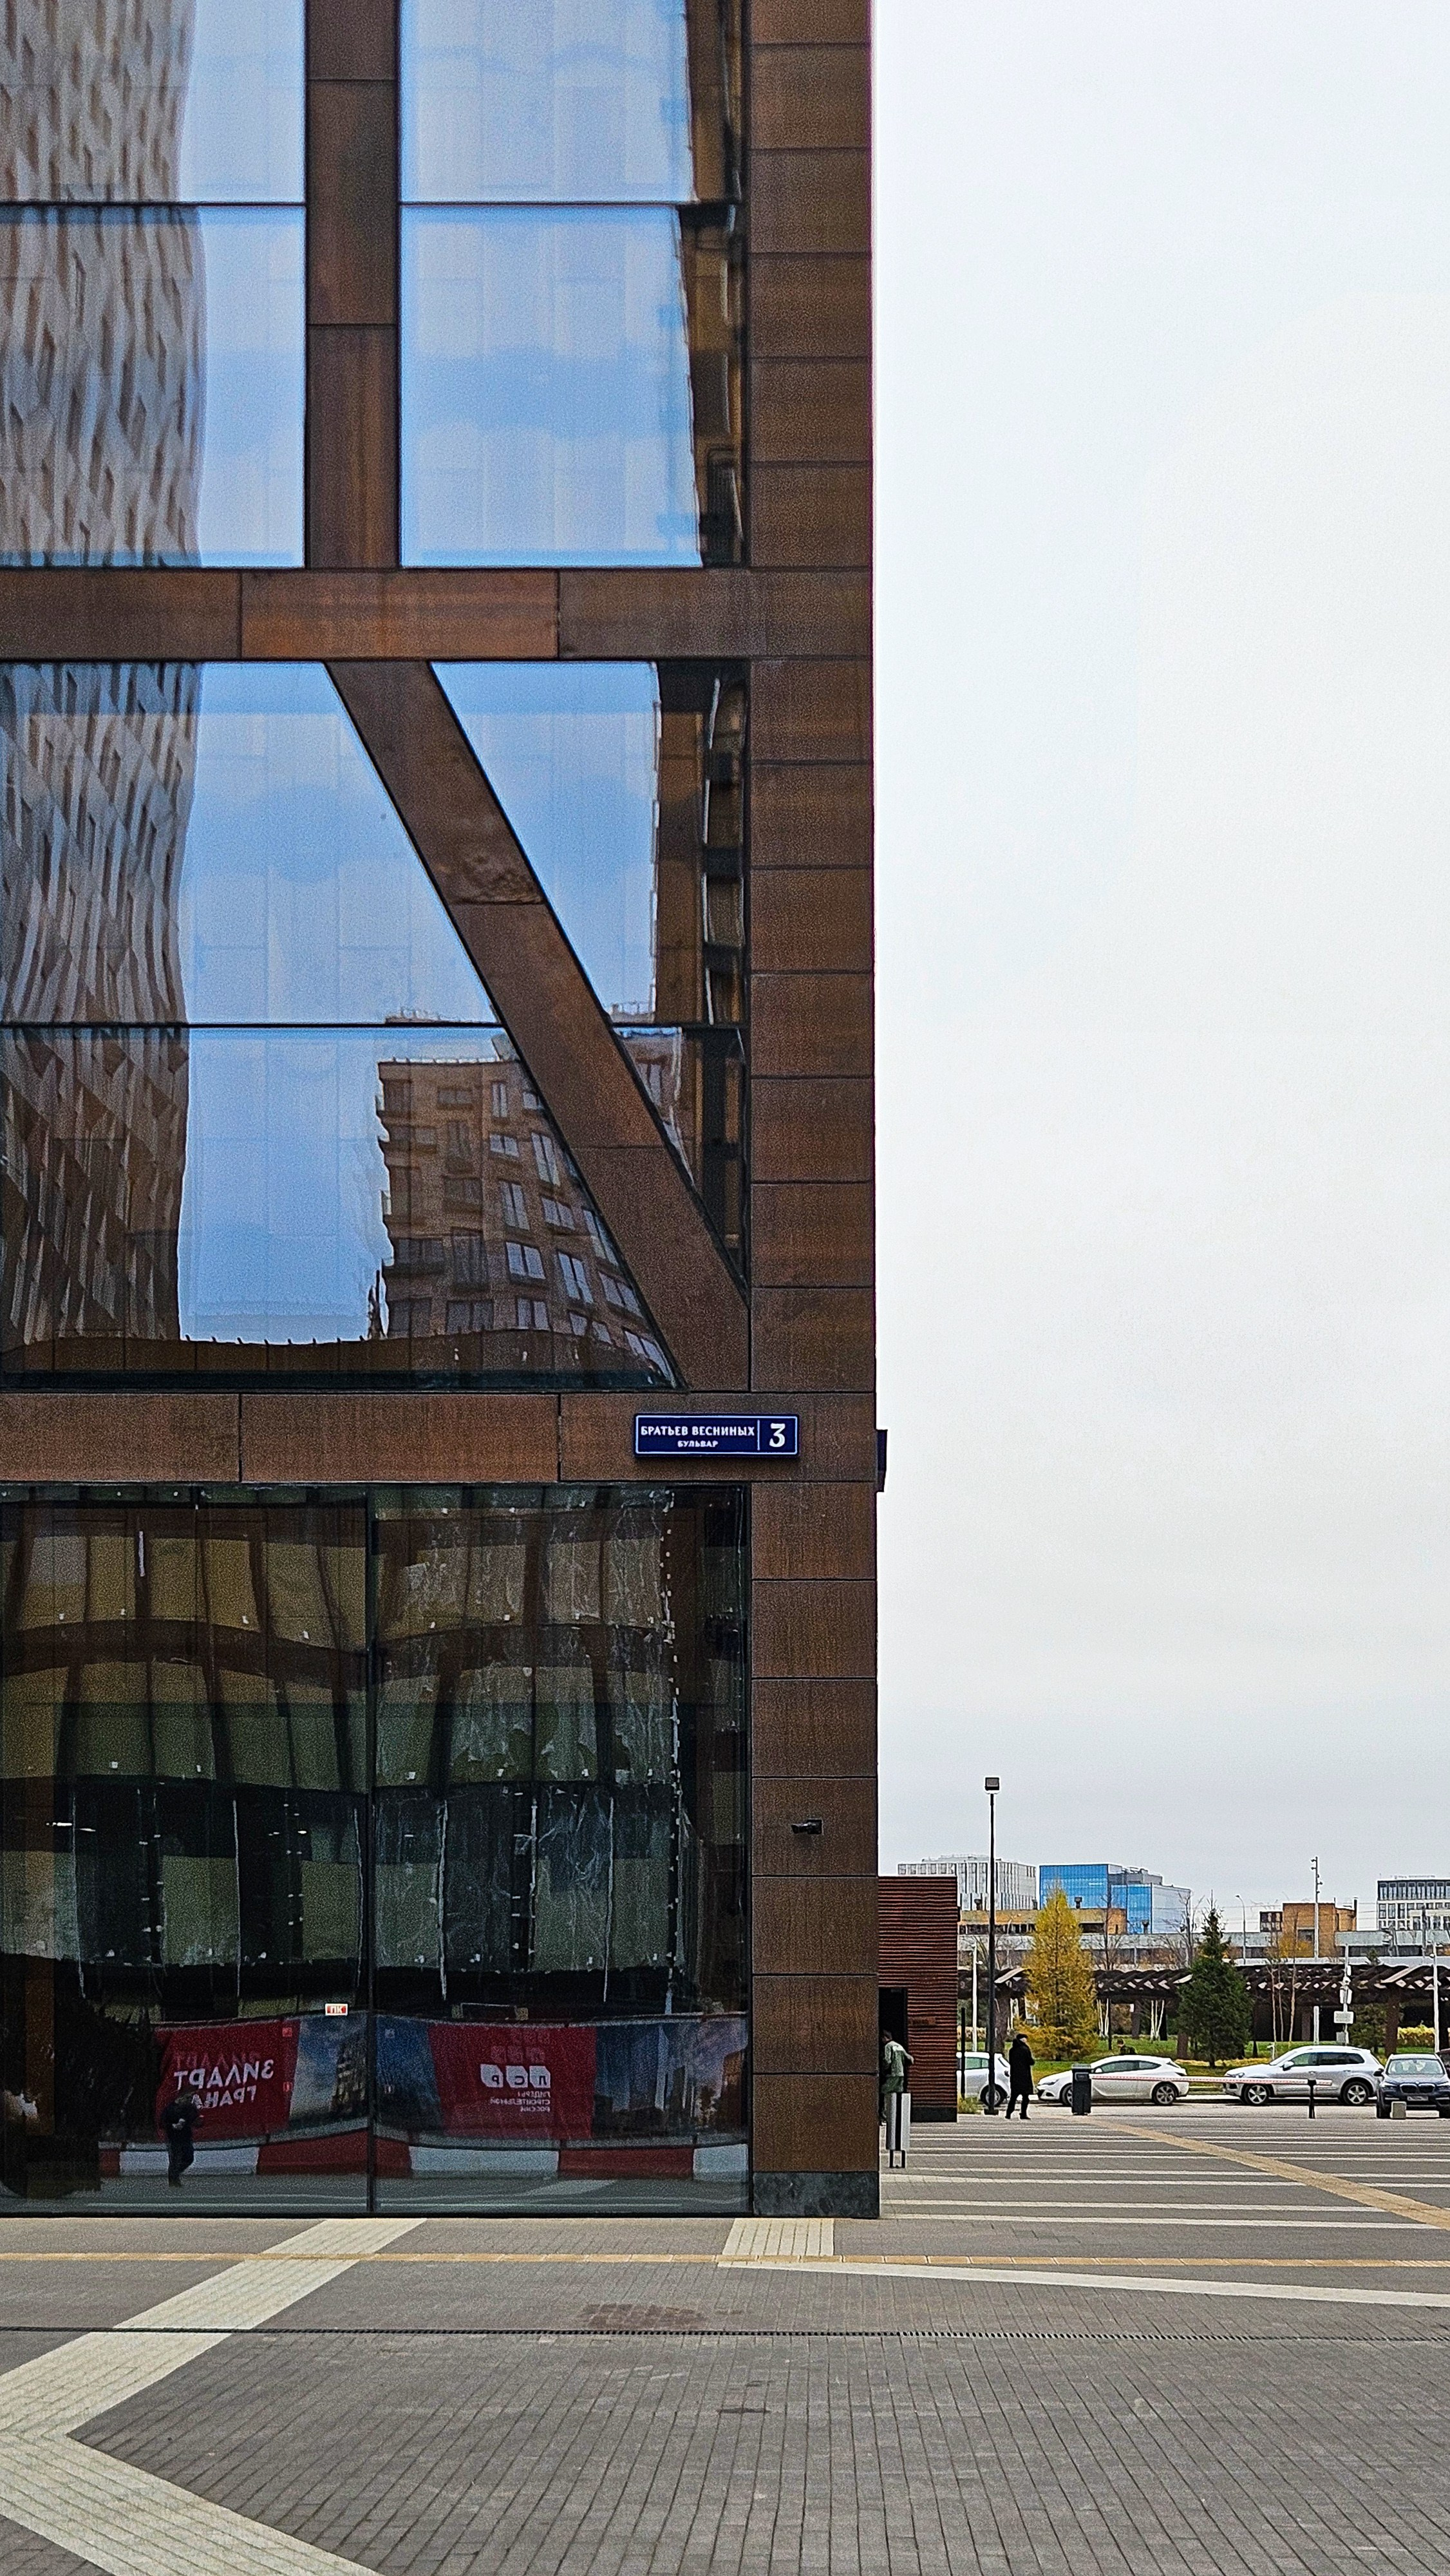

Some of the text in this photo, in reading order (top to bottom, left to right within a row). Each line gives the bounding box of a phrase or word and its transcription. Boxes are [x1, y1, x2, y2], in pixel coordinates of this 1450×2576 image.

[641, 1426, 755, 1436] БРАТЬЕВ ВЕСНИНЫХ
[769, 1423, 786, 1448] 3
